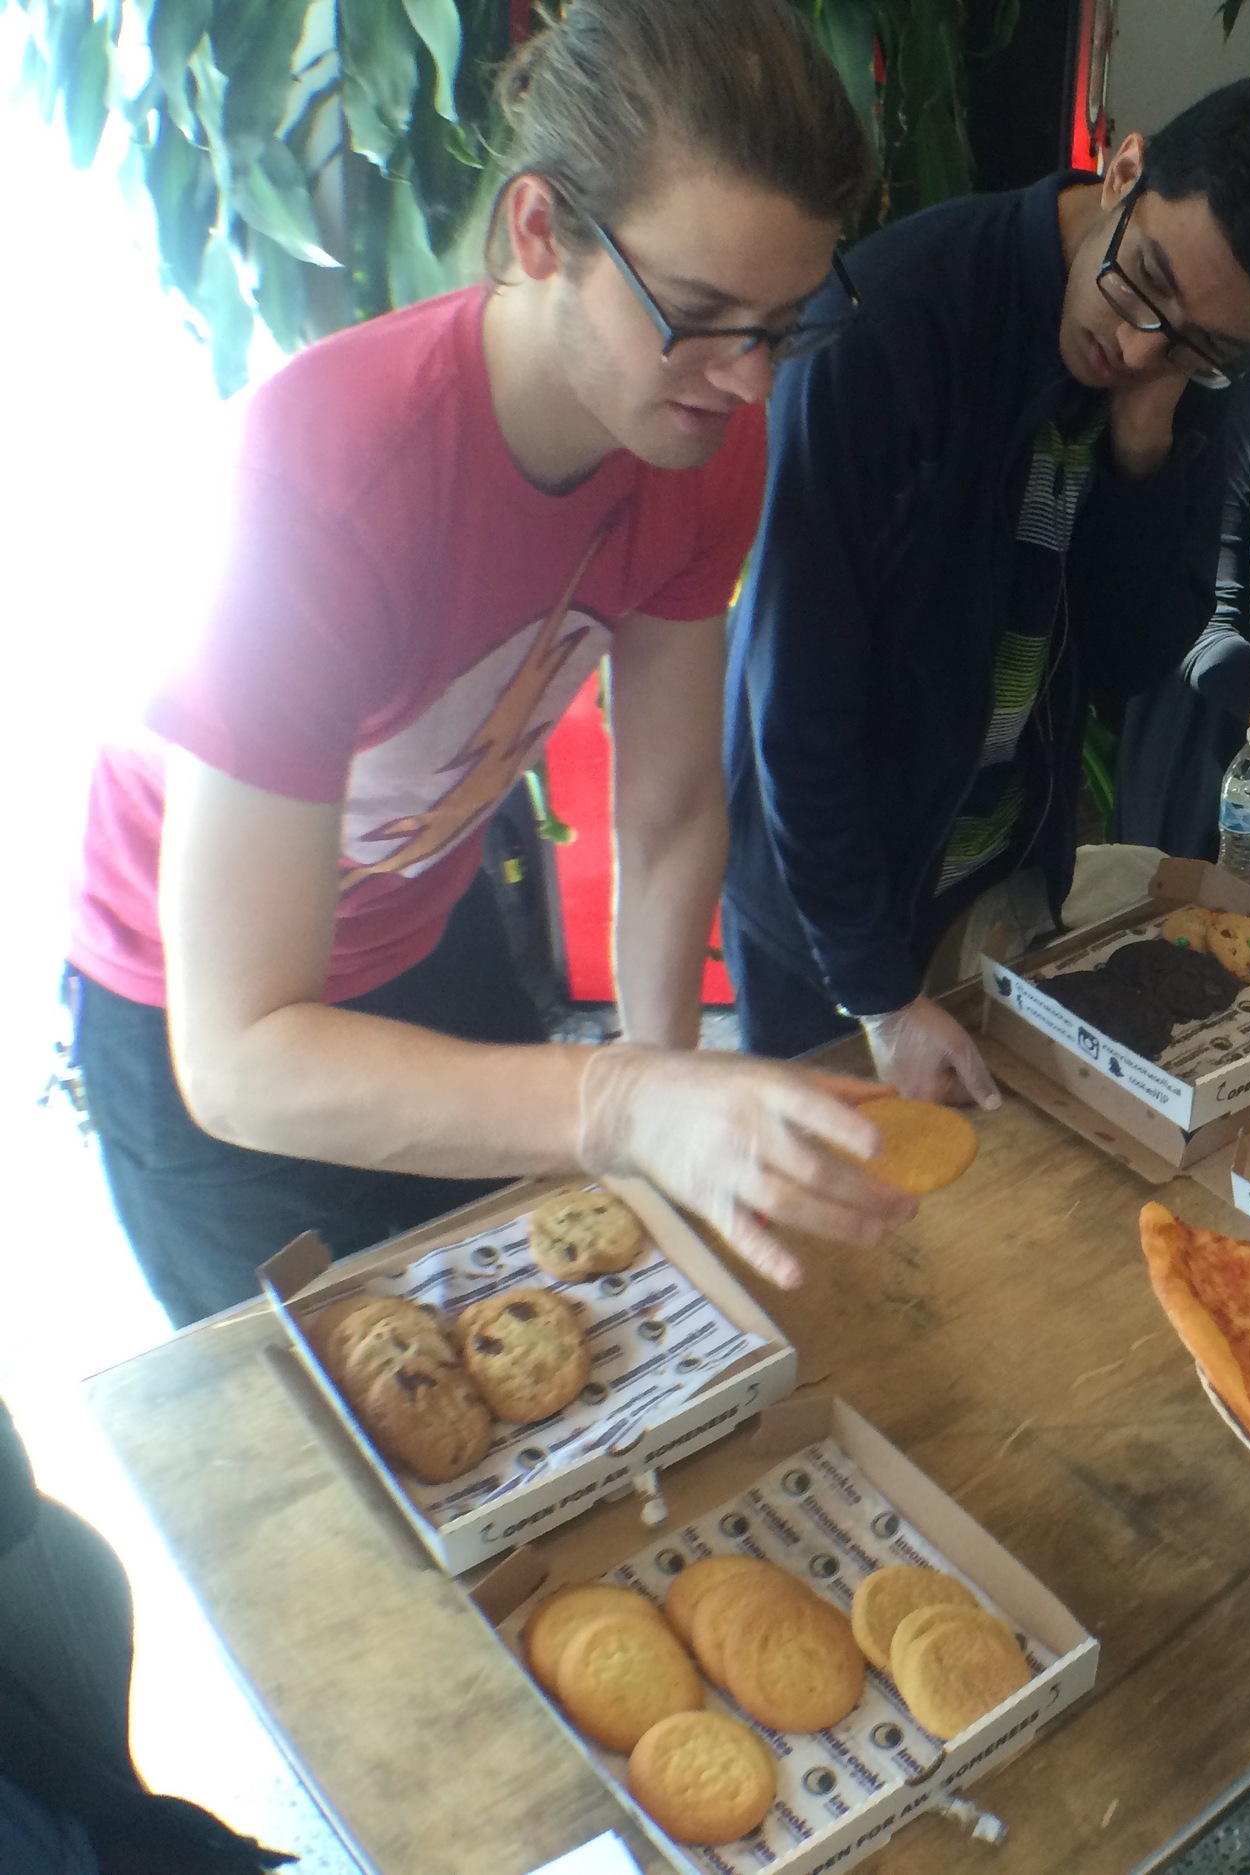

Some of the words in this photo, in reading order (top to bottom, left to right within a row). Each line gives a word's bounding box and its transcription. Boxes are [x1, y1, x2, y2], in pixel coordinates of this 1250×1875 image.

[503, 1503, 556, 1538] OPEN
[559, 1481, 598, 1509] FOR
[807, 1844, 852, 1875] PEN
[856, 1813, 895, 1848] FOR
